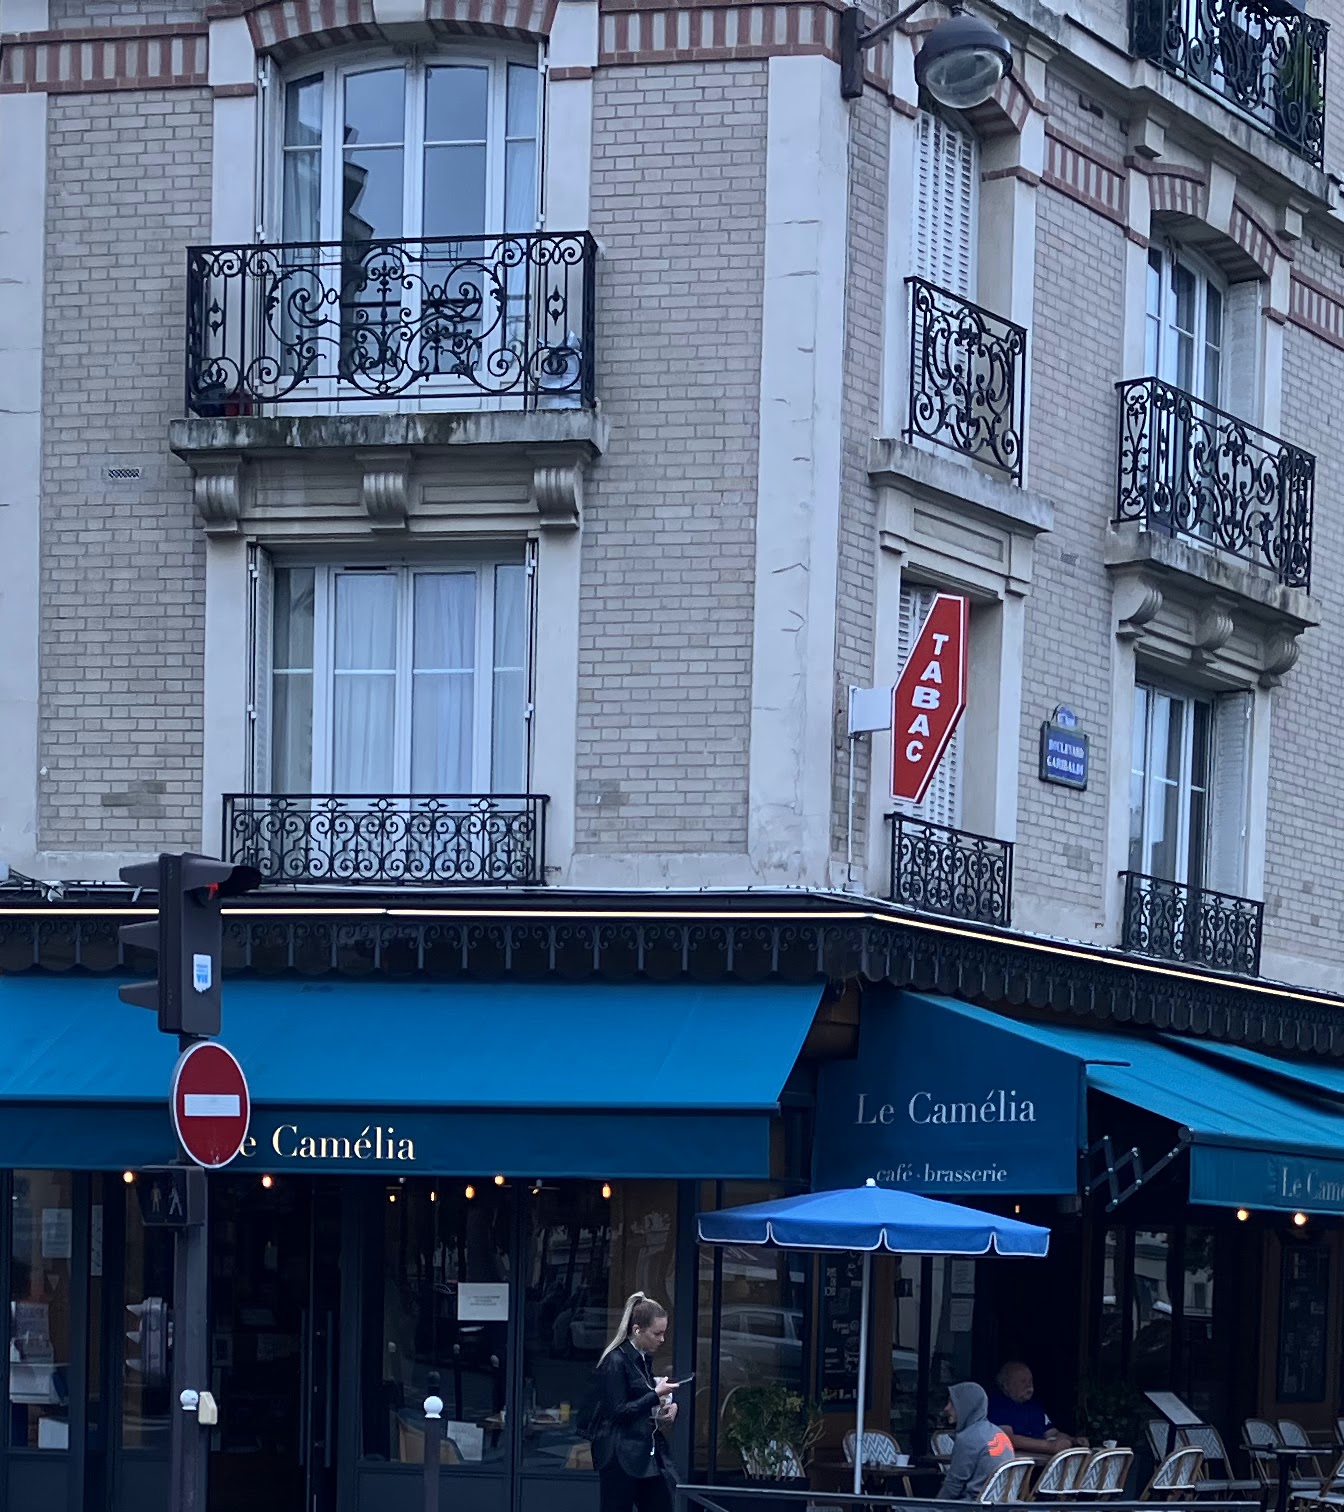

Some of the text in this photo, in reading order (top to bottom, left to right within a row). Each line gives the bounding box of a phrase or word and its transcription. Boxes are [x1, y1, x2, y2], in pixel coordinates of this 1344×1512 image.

[906, 633, 949, 763] TABAC
[1046, 755, 1084, 776] GARIBALDI
[854, 1089, 1036, 1125] Le Camélia
[239, 1124, 416, 1160] e Camélia
[876, 1163, 1007, 1183] café brasserie
[1282, 1166, 1302, 1198] Le
